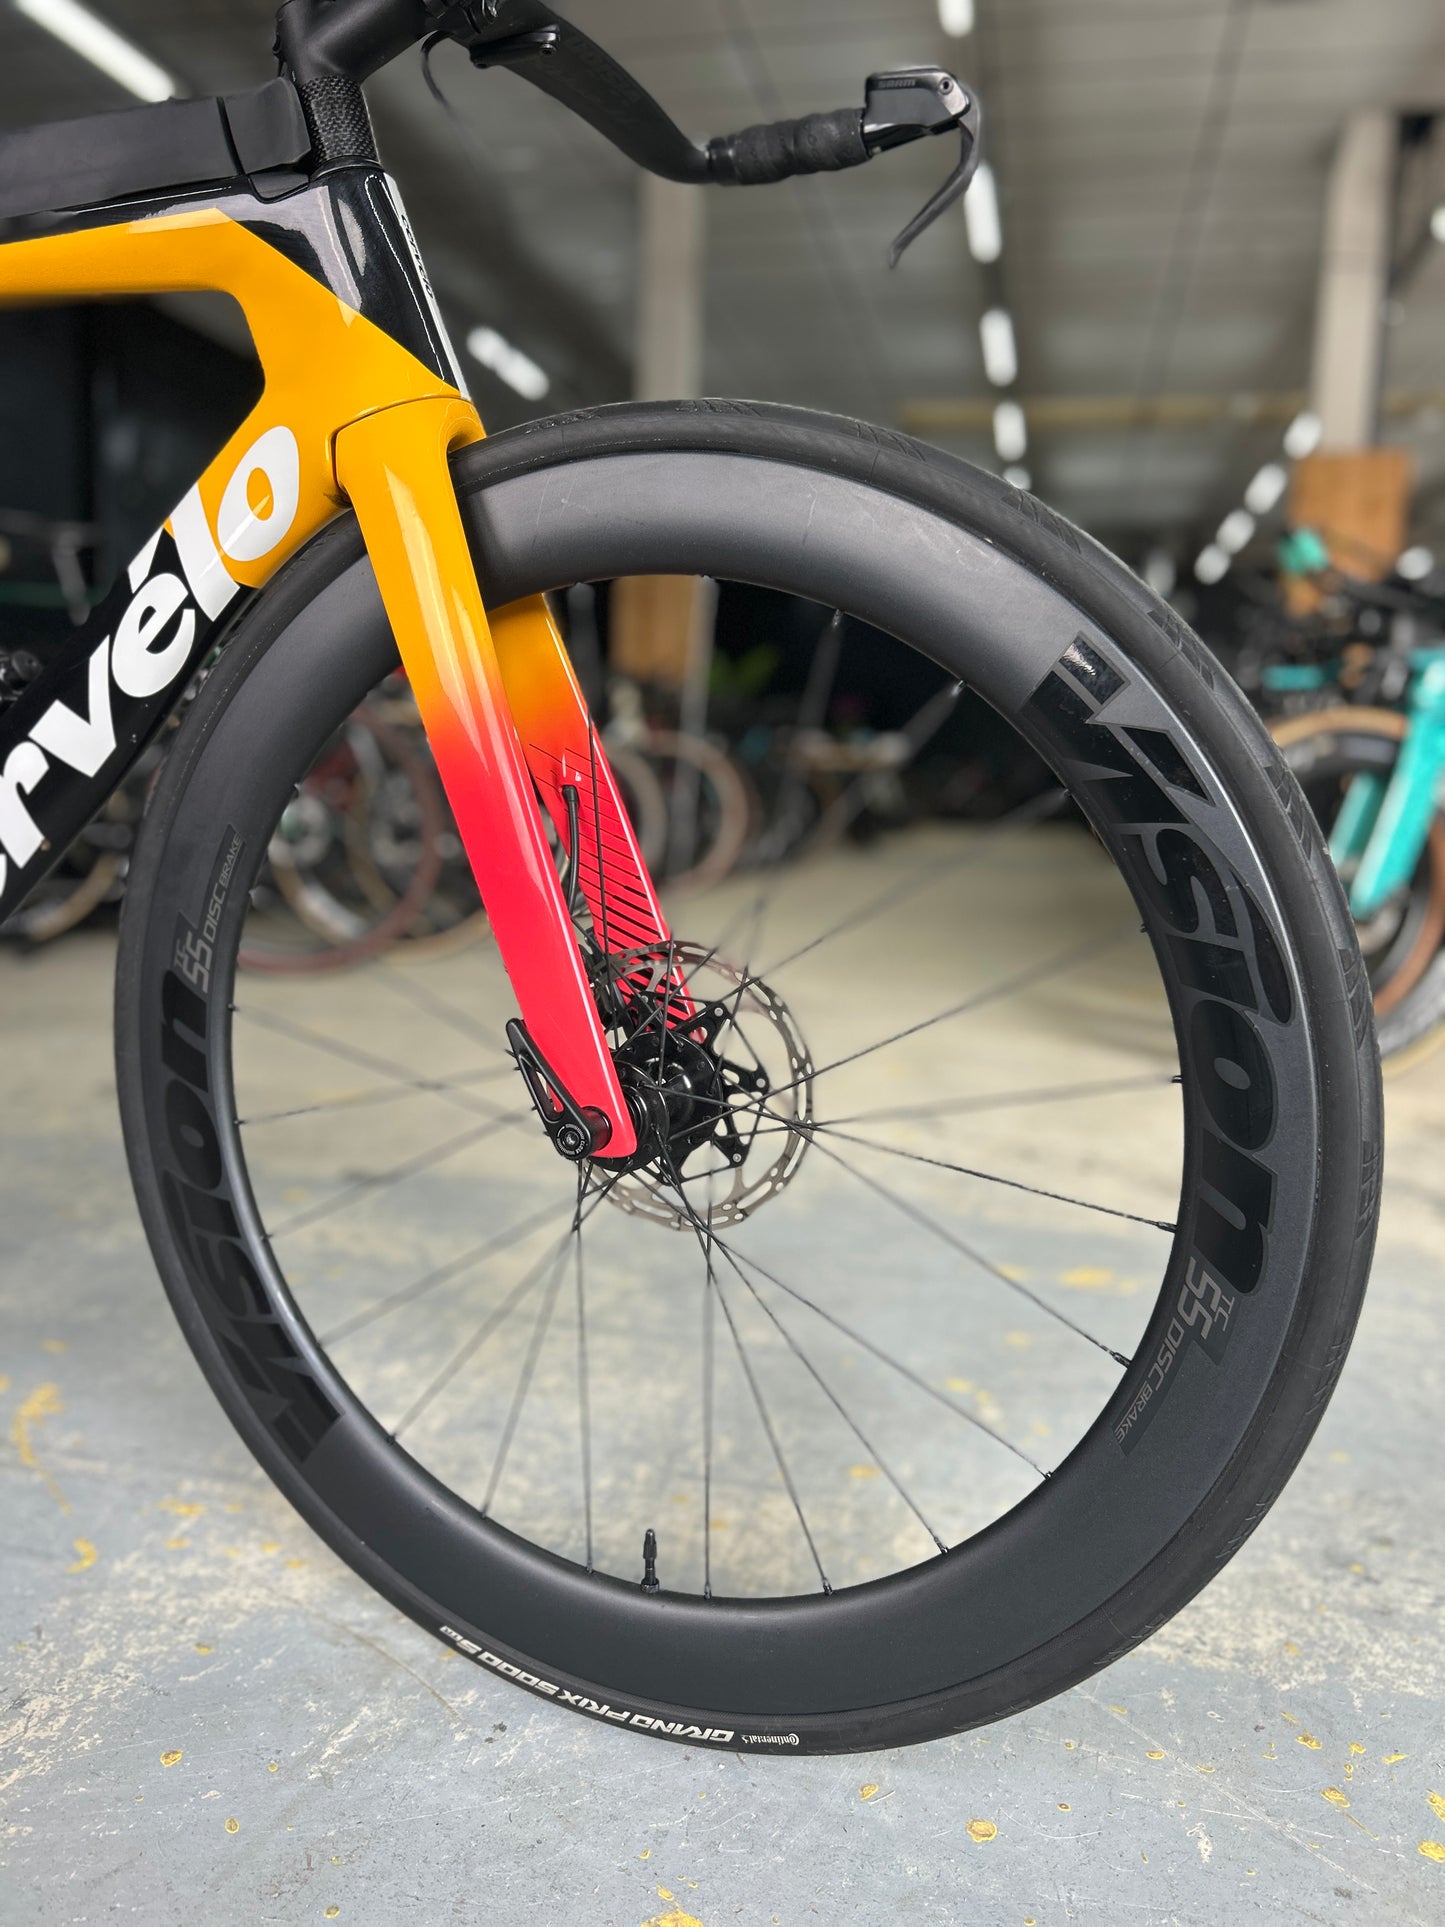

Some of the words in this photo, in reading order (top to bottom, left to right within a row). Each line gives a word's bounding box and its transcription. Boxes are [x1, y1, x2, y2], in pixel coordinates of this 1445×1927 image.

[203, 883, 226, 943] DISC
[219, 832, 243, 888] BRAKE
[1177, 1256, 1221, 1340] 55
[1214, 1296, 1235, 1332] TC
[1148, 1317, 1184, 1391] DISC
[1114, 1380, 1153, 1443] BRAKE
[477, 1651, 560, 1695] 5000
[557, 1689, 631, 1722] PRIX
[629, 1715, 735, 1742] GRAND
[749, 1733, 800, 1746] Continental
